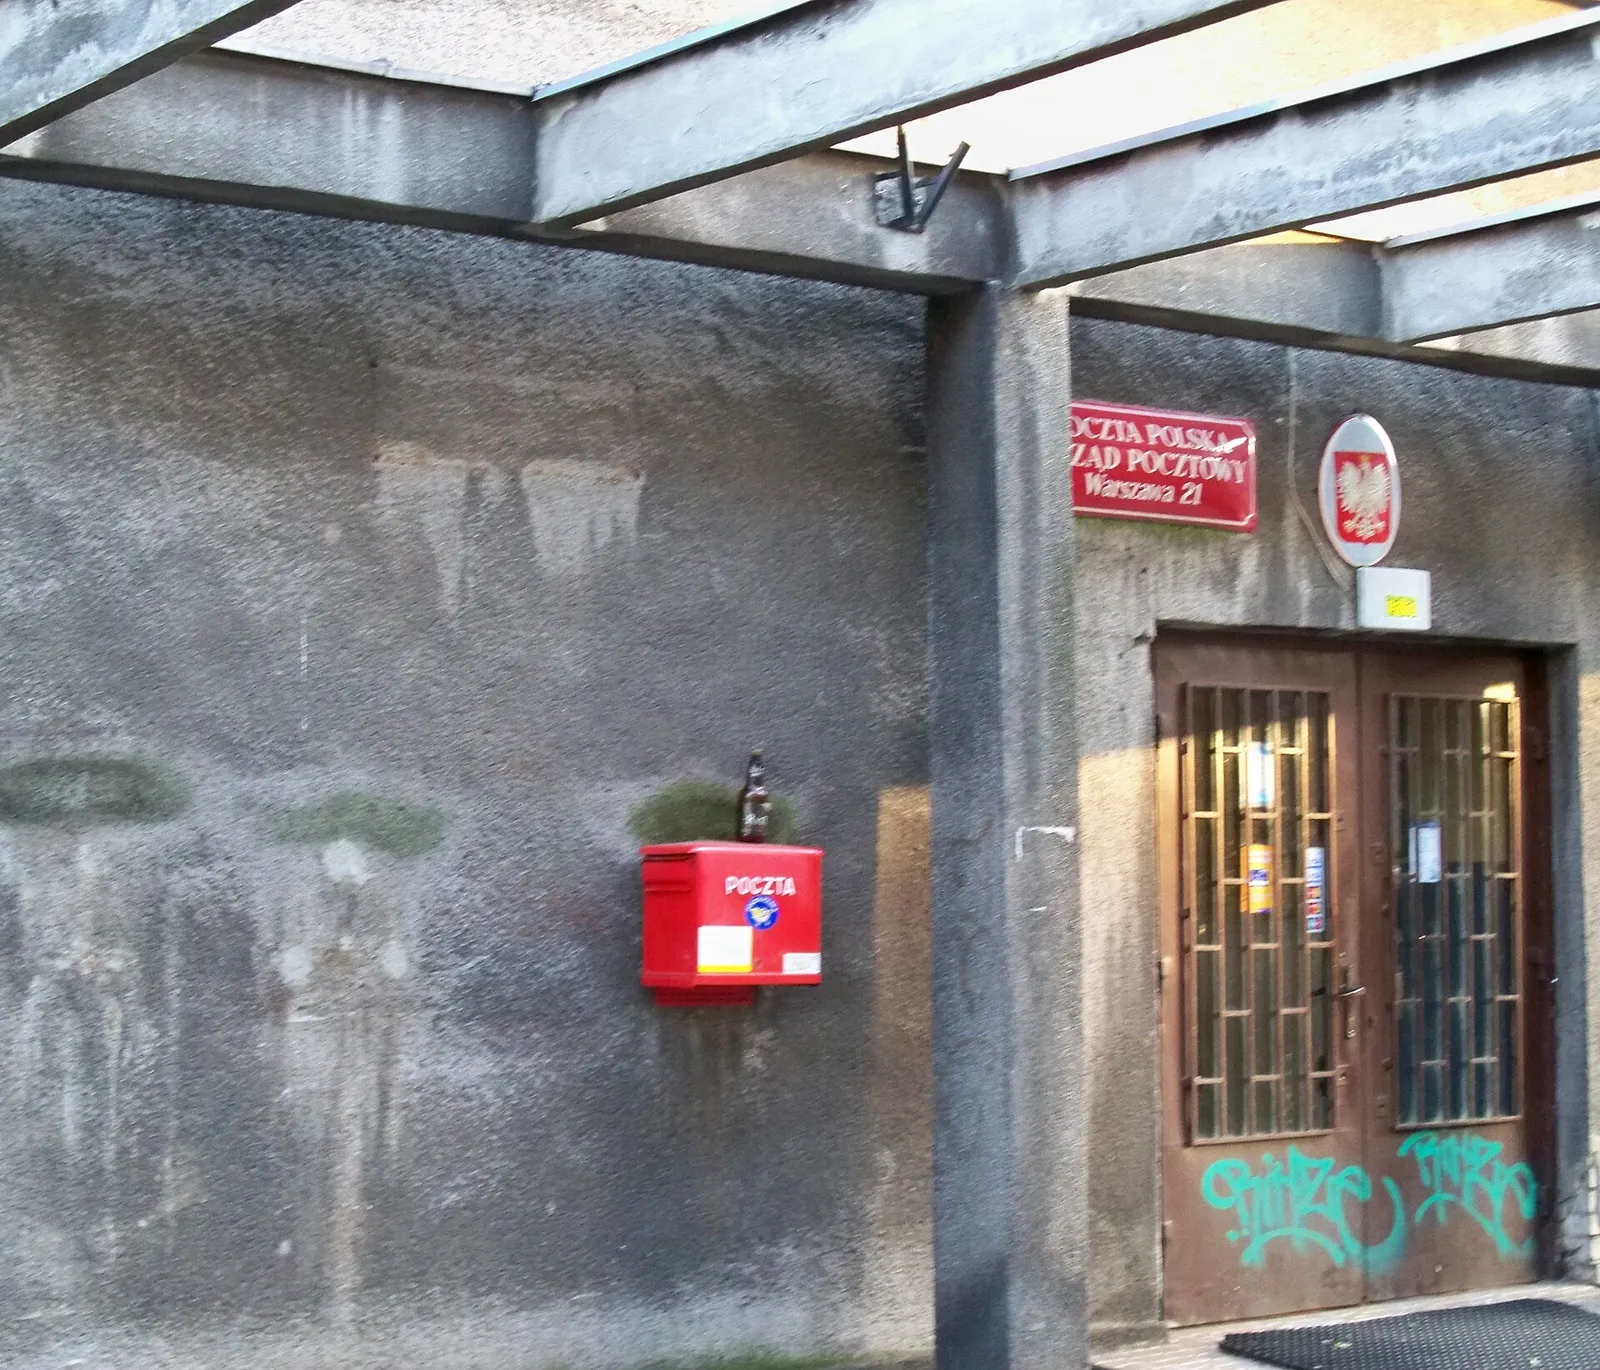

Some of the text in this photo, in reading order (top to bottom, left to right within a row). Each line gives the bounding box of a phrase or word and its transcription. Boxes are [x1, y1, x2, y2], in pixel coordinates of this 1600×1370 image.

[1069, 415, 1234, 453] OCZTA POLSKA
[1069, 443, 1247, 483] ZĄD POCZTOWY
[1084, 472, 1203, 505] Warszawa 21
[725, 875, 797, 896] POCZTA
